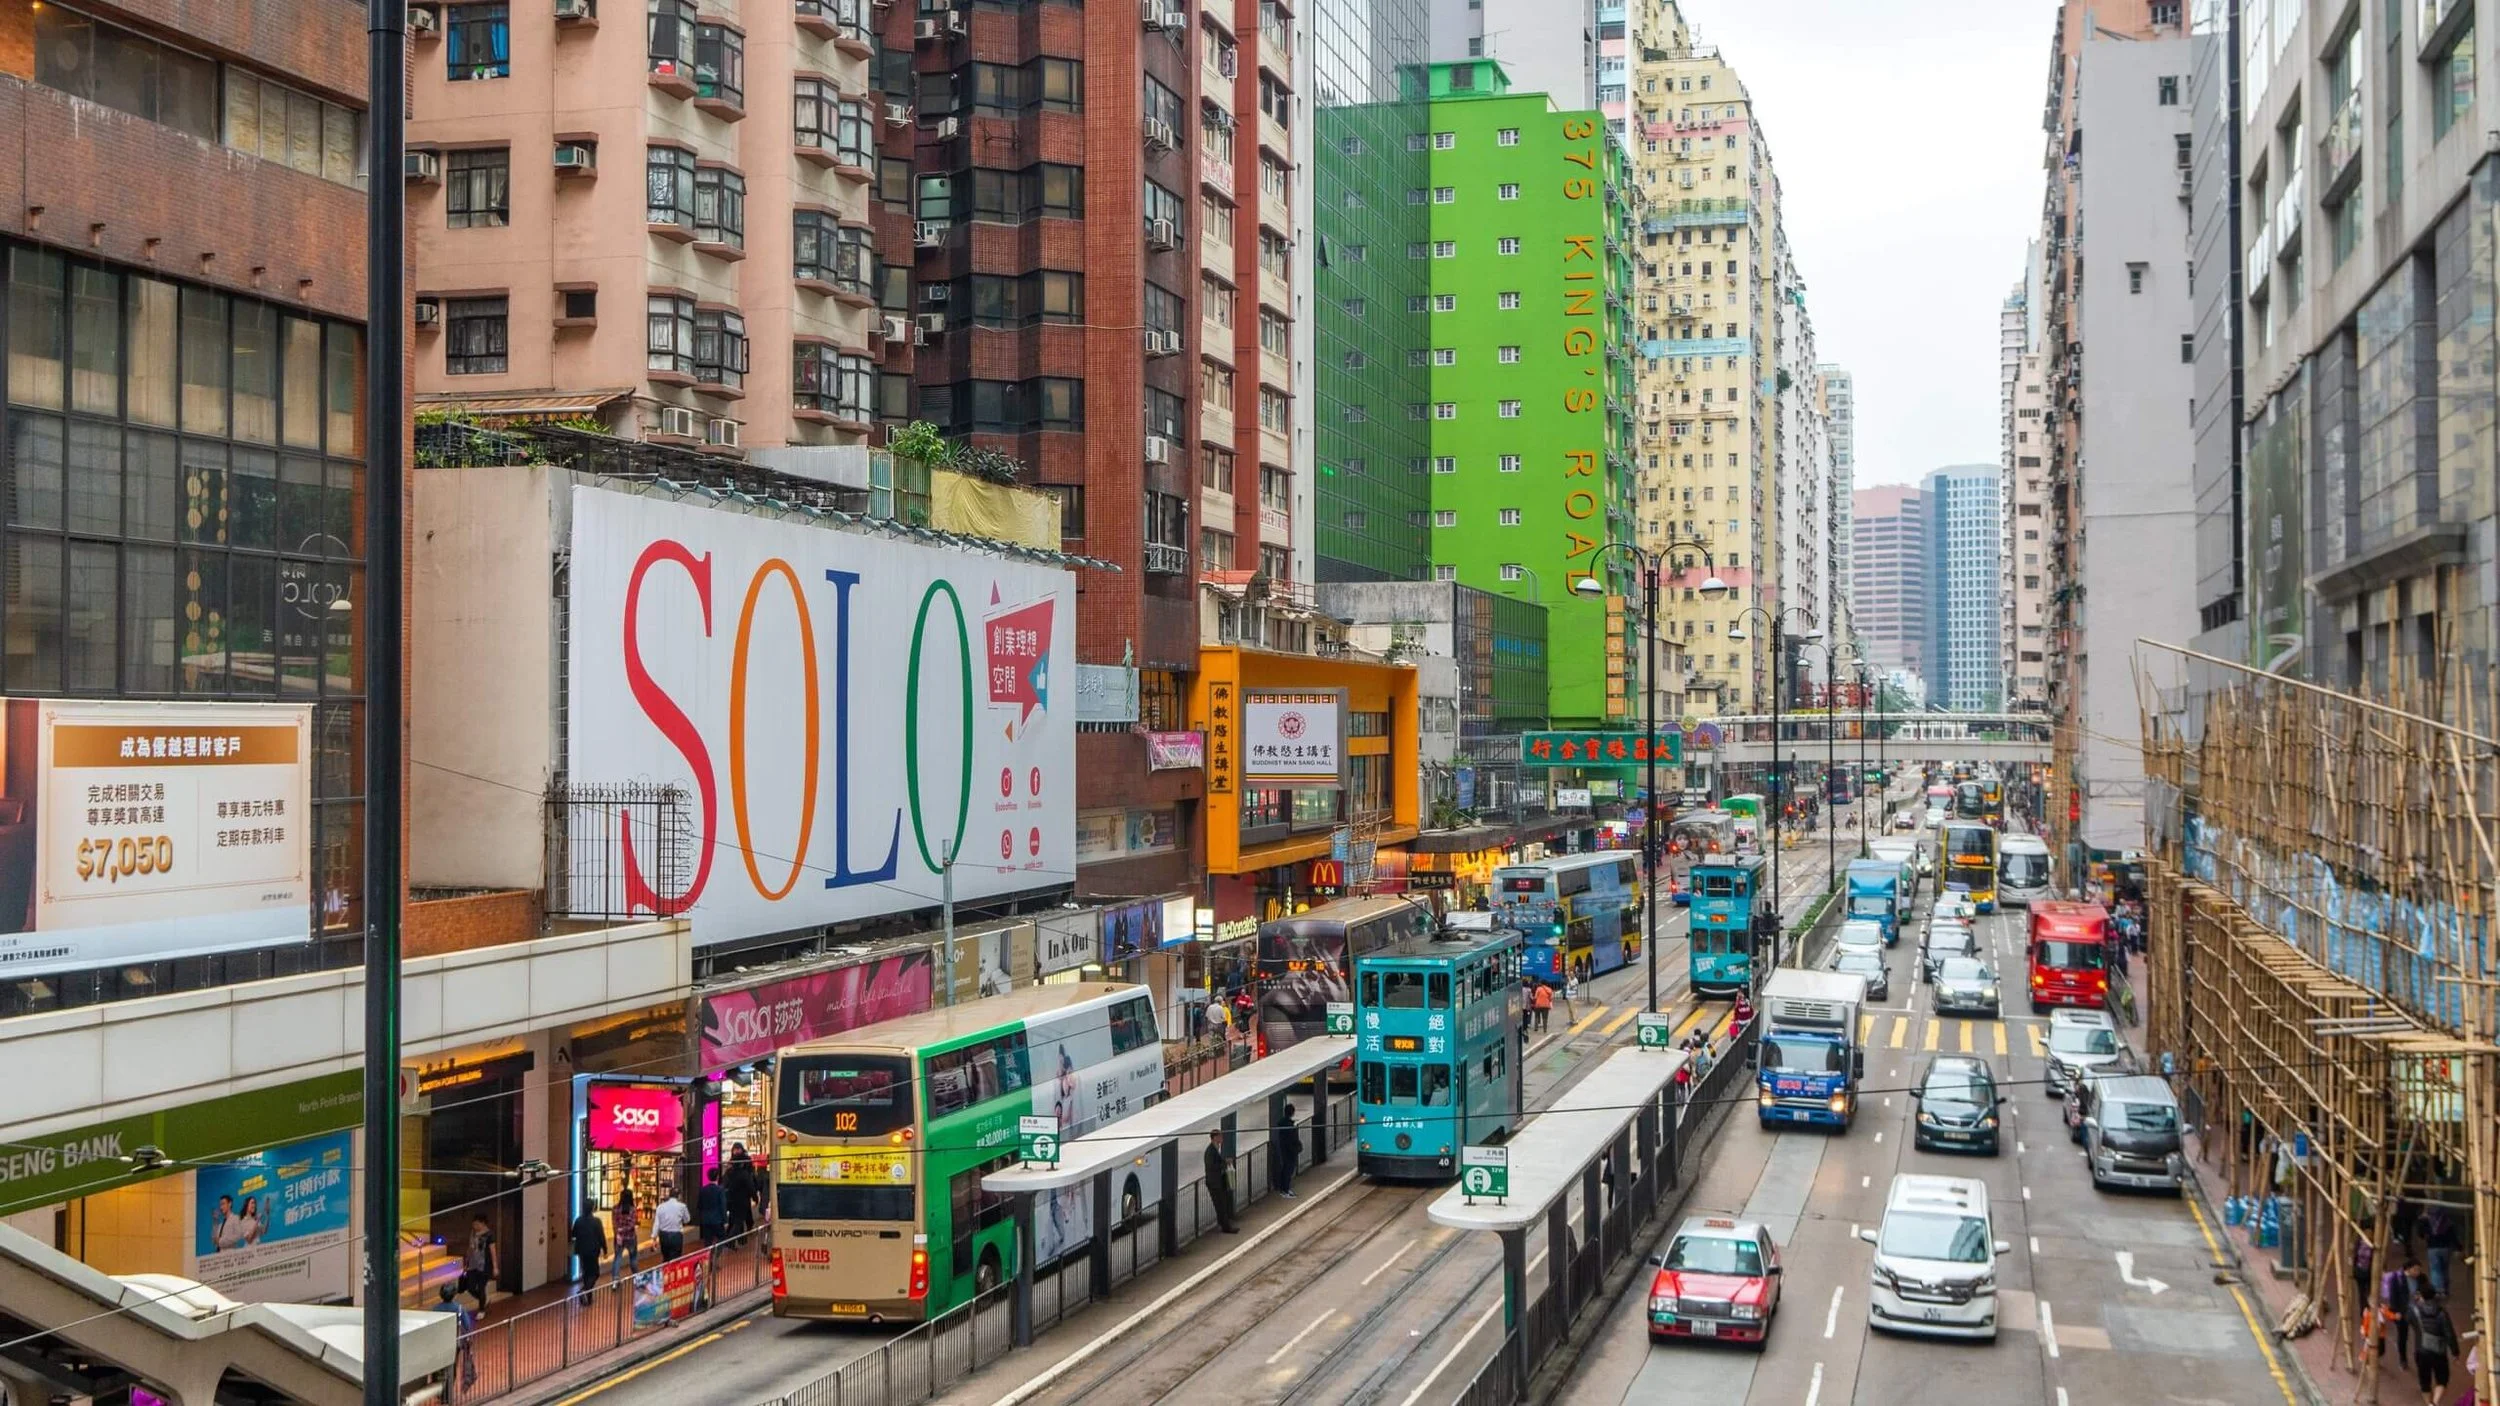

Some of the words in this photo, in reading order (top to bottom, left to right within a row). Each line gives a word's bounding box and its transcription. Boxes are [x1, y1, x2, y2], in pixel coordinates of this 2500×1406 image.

[1564, 120, 1594, 199] 375
[1564, 235, 1596, 414] KING'S
[1564, 450, 1596, 597] ROAD
[993, 626, 1037, 657] 創業理想
[993, 664, 1015, 694] 空間
[622, 539, 973, 918] SOLO
[120, 736, 241, 758] 成為優越理財客戶
[87, 783, 165, 802] 完成相關交易
[87, 806, 165, 826] 尊享獎賞高達
[216, 799, 285, 818] 尊享港元特惠
[216, 827, 285, 848] 定期存款利率
[76, 835, 173, 884] $7,050
[1217, 916, 1257, 943] McDonald's
[1048, 938, 1060, 960] In
[1072, 932, 1089, 952] Out
[775, 998, 803, 1035] 莎莎
[1366, 1012, 1380, 1052] 慢活
[1429, 1014, 1445, 1053] 絕對
[299, 1100, 319, 1113] North
[320, 1096, 338, 1108] Point
[338, 1090, 362, 1105] Branch
[835, 1113, 857, 1132] 102
[63, 1131, 123, 1168] BANK
[1439, 1158, 1449, 1166] 40
[285, 1168, 341, 1203] 引領付款
[285, 1195, 326, 1226] 新方式
[799, 1249, 830, 1263] KMB
